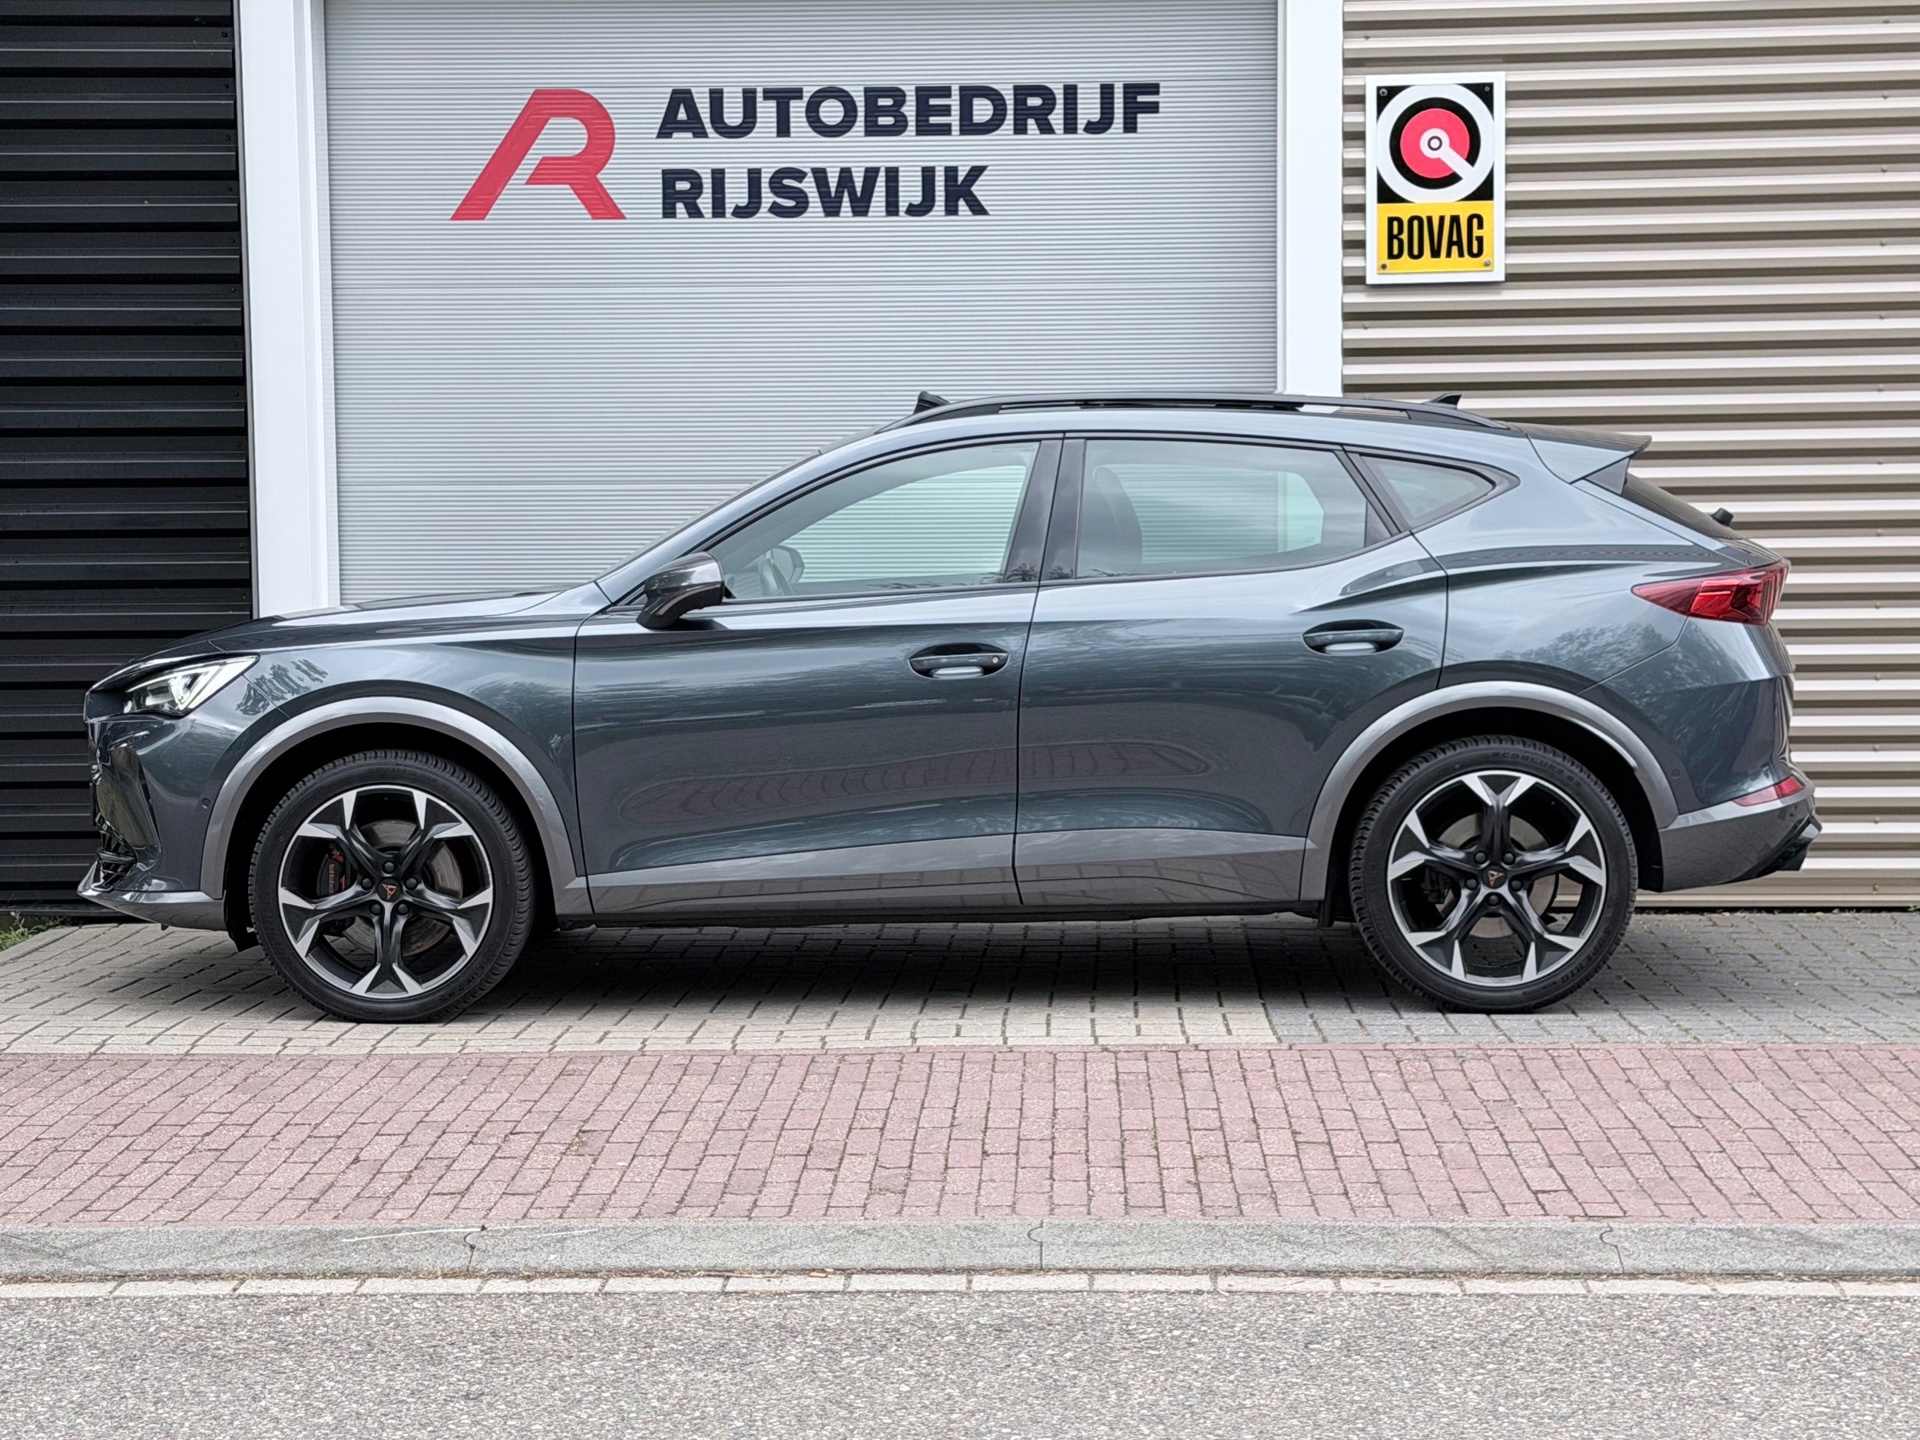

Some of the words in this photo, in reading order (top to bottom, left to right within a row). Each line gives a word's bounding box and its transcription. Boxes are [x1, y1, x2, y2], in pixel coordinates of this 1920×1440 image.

[656, 83, 1160, 139] AUTOBEDRIJF
[661, 166, 989, 219] RIJSWIJK
[1387, 213, 1484, 260] BOVAG
